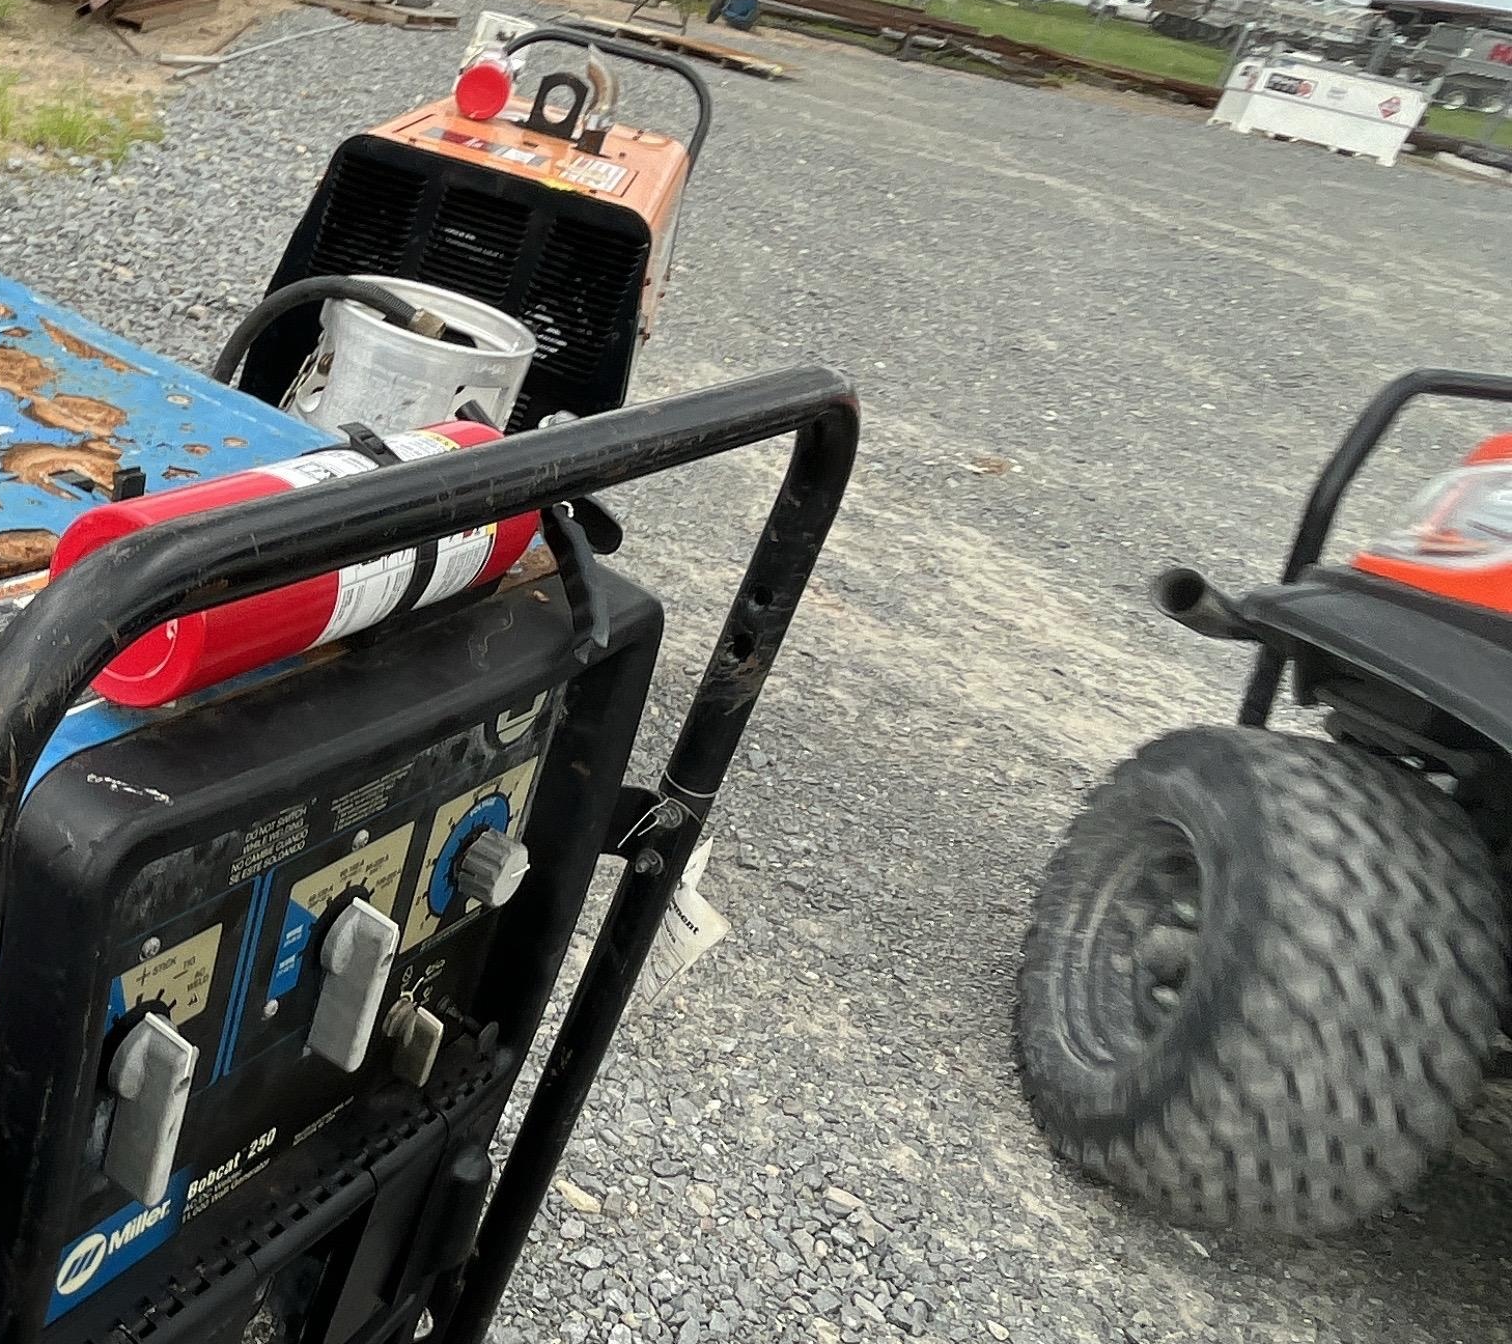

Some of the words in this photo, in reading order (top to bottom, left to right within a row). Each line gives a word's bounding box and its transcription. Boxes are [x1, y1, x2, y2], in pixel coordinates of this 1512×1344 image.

[187, 1151, 241, 1201] Bobcat
[247, 1127, 277, 1160] 250
[108, 1198, 171, 1255] Miller
